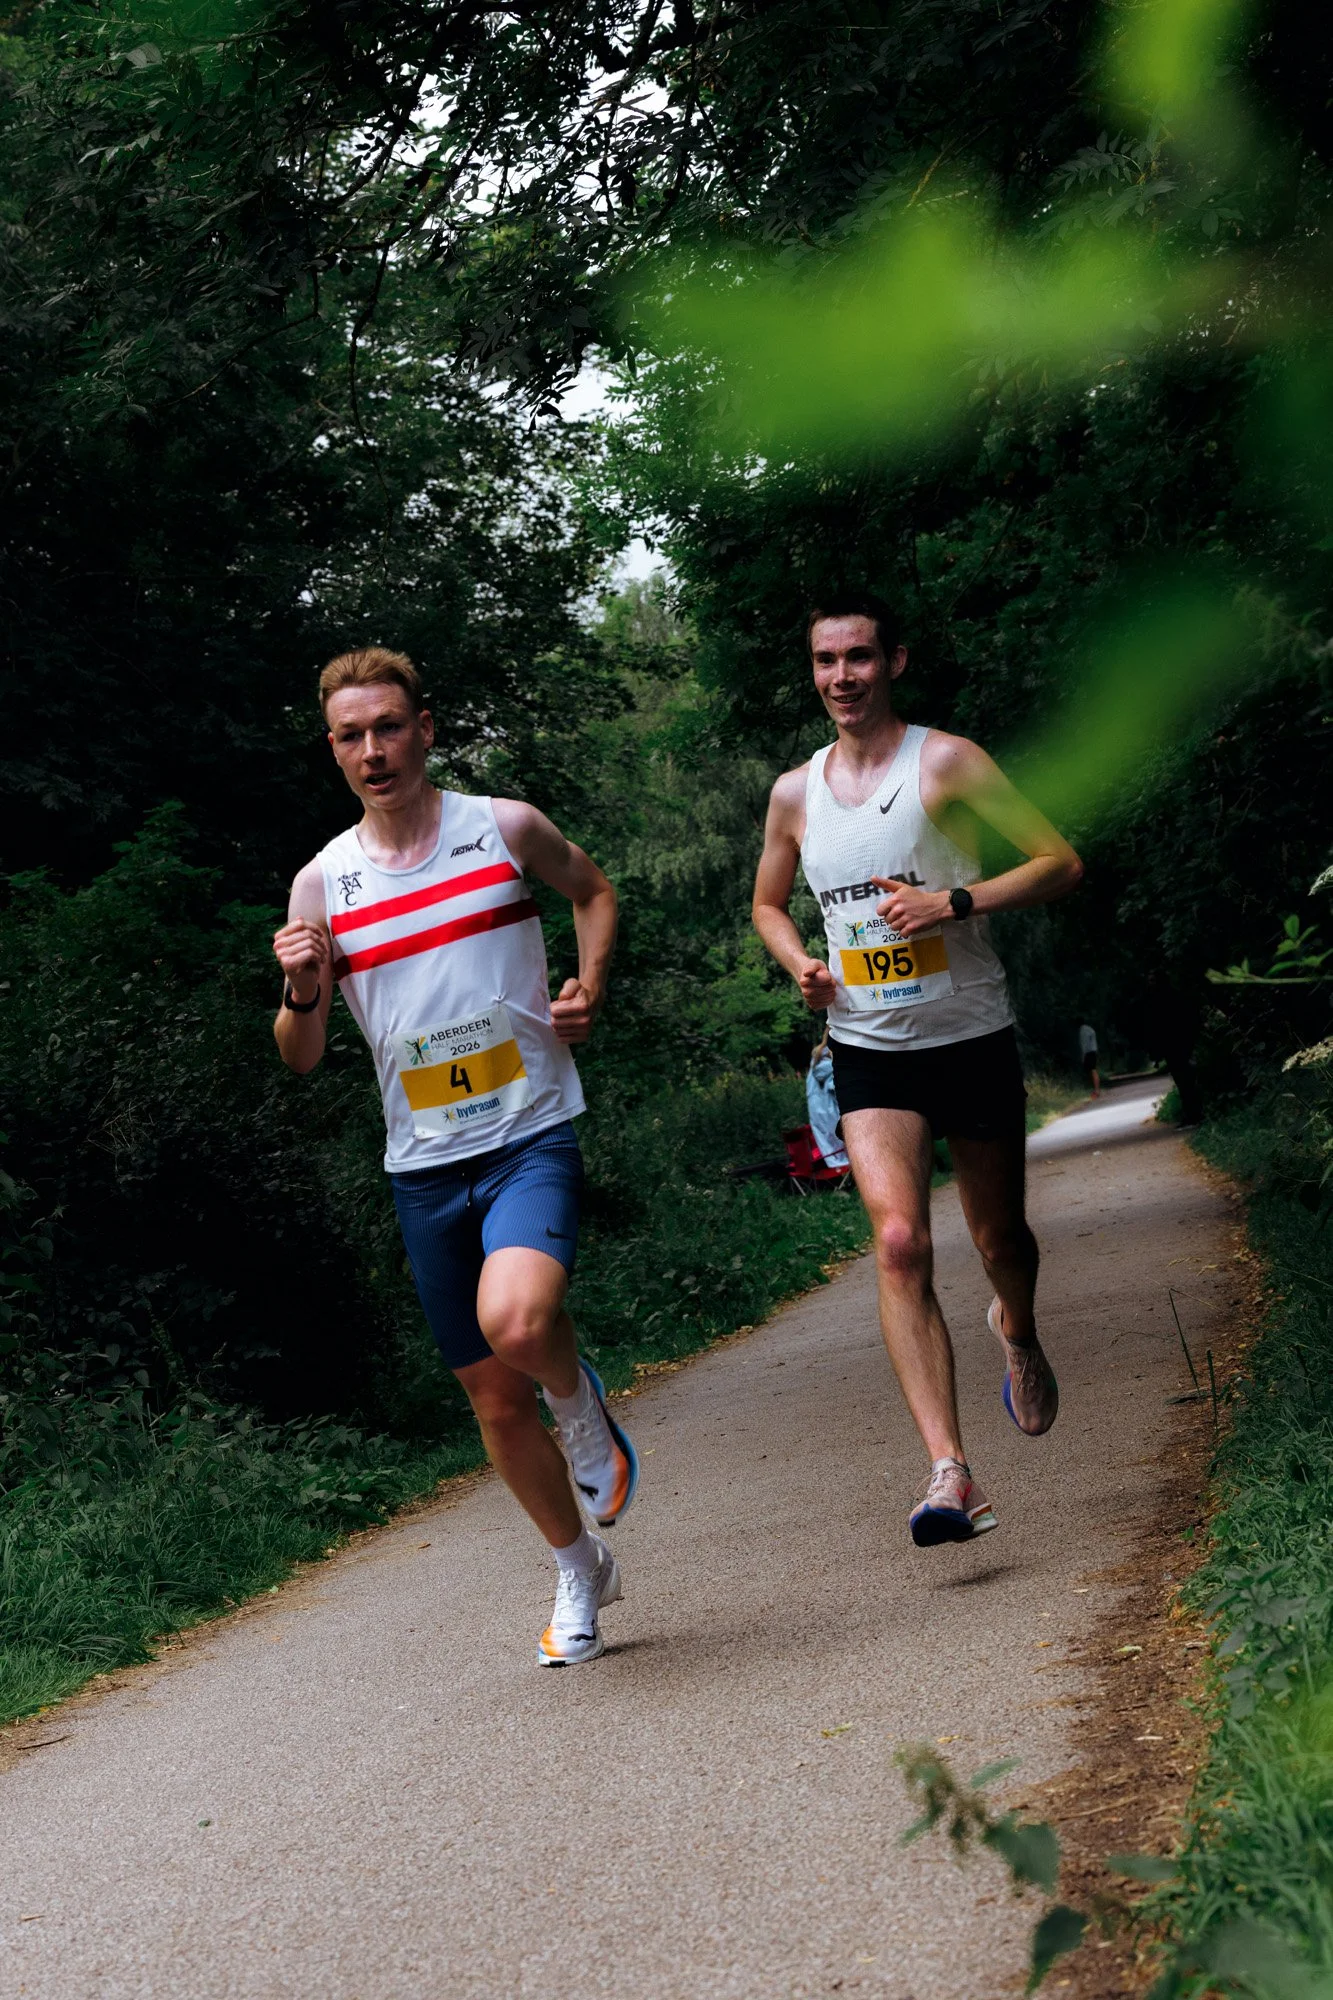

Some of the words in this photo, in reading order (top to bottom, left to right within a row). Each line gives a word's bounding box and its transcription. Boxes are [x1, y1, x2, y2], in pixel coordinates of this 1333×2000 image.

[863, 947, 914, 981] 195
[882, 985, 922, 999] hydrasun
[430, 1017, 491, 1043] ABERDEEN
[431, 1040, 450, 1050] HALF
[452, 1028, 494, 1045] MARATHON
[450, 1041, 480, 1056] 2026
[450, 1064, 473, 1094] 4
[456, 1097, 501, 1118] hydrasun
